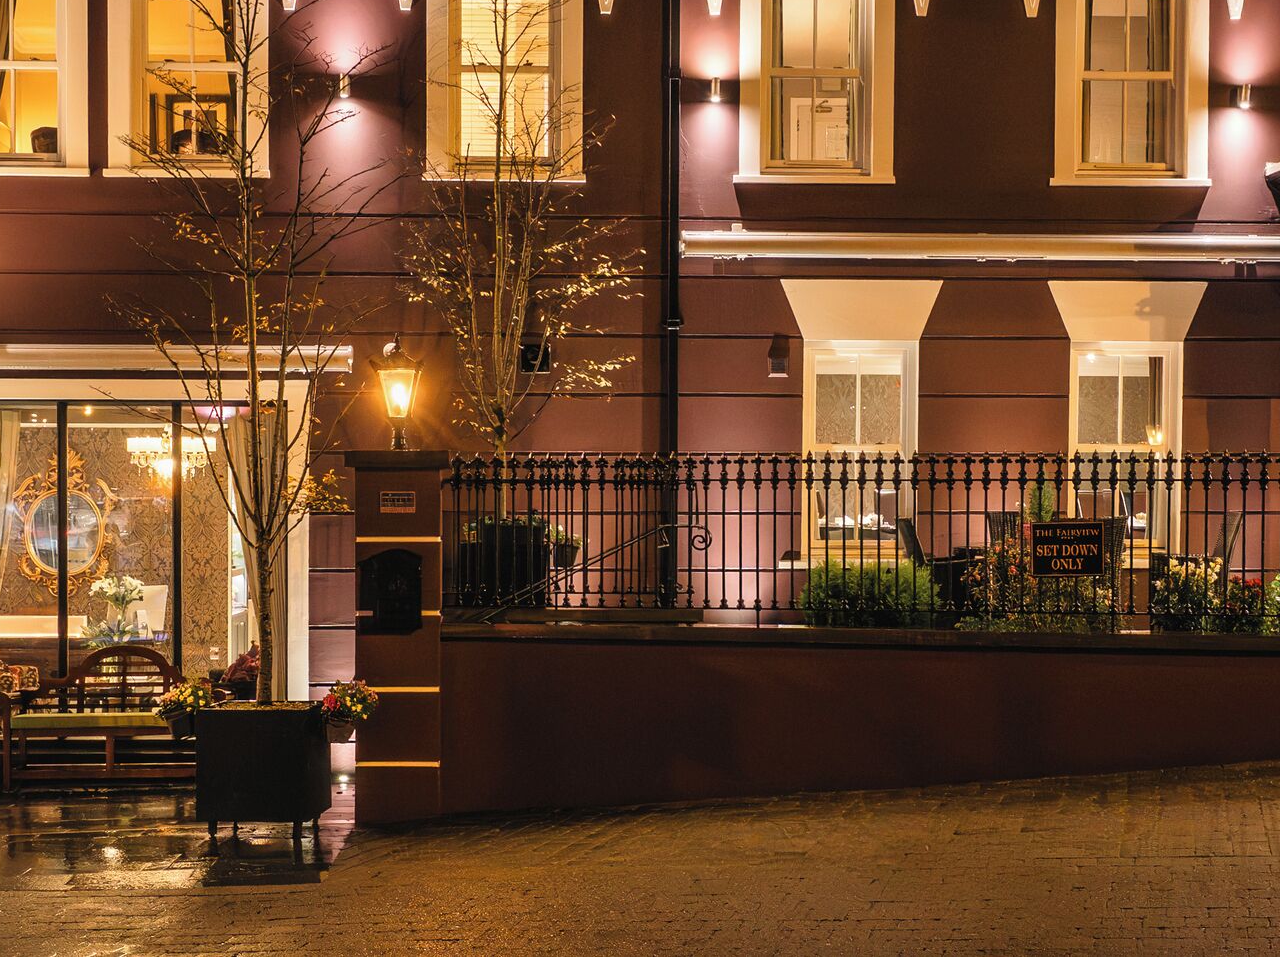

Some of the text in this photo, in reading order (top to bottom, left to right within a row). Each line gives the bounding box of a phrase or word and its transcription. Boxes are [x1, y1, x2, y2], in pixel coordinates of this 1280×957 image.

[1035, 529, 1052, 537] THE
[1036, 544, 1098, 557] SET DOWN
[1051, 558, 1084, 570] ONLY
